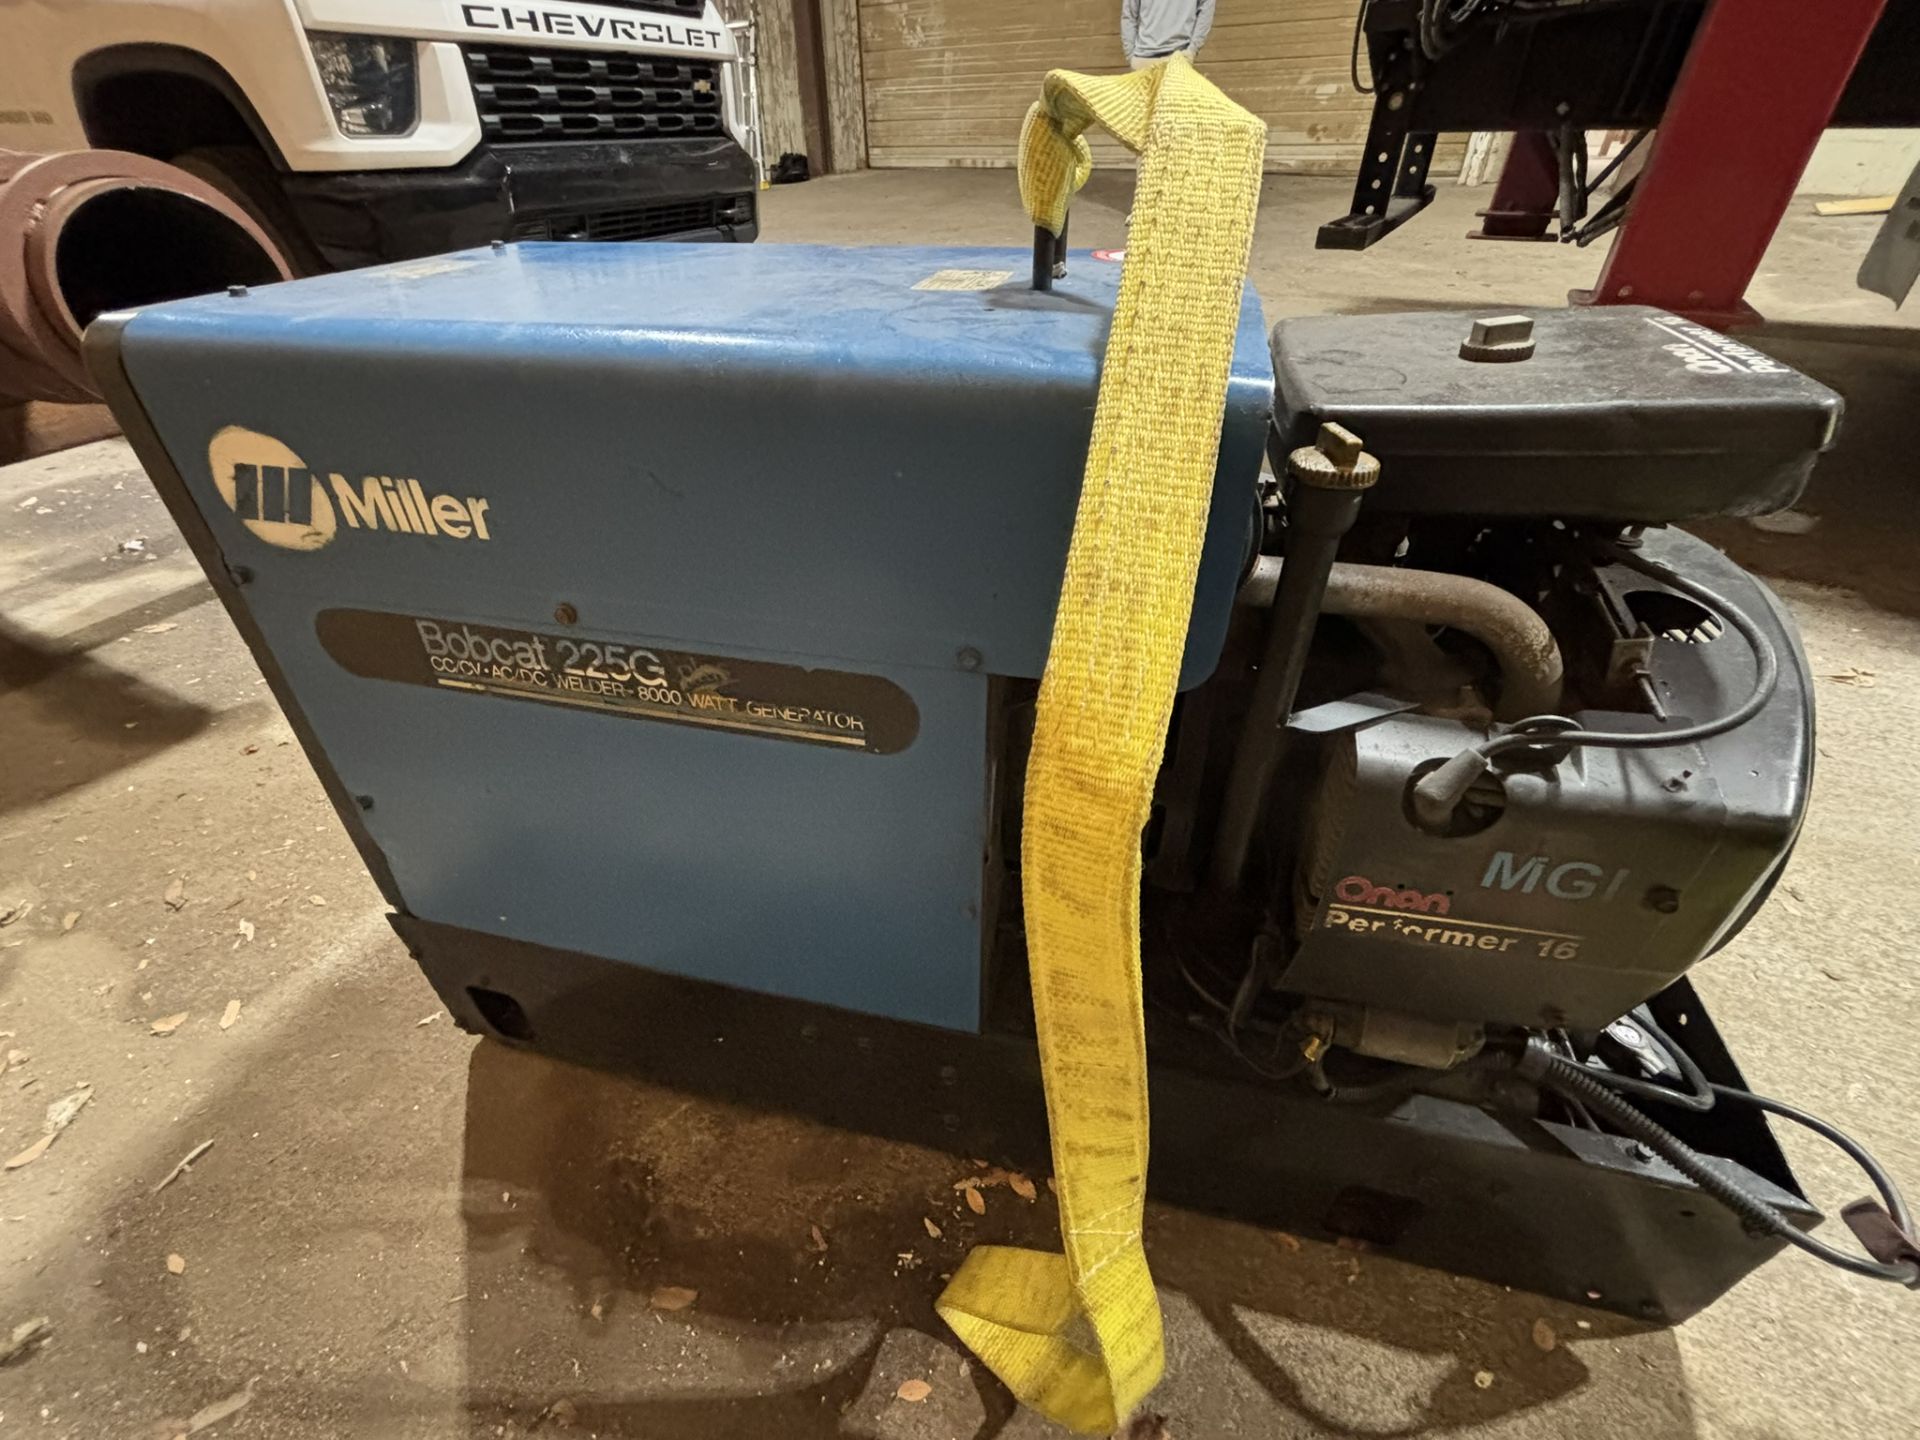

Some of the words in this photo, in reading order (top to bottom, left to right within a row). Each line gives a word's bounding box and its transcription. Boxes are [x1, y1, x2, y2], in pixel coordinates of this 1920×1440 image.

[461, 4, 721, 49] CHEVROLET
[329, 472, 491, 541] Miller
[415, 618, 550, 672] Bobcat
[556, 639, 669, 688] 225G
[637, 685, 682, 706] 8000
[687, 692, 738, 714] WATT
[746, 699, 865, 732] GENERATOR
[1335, 875, 1451, 914] Onan
[1537, 939, 1581, 960] 16
